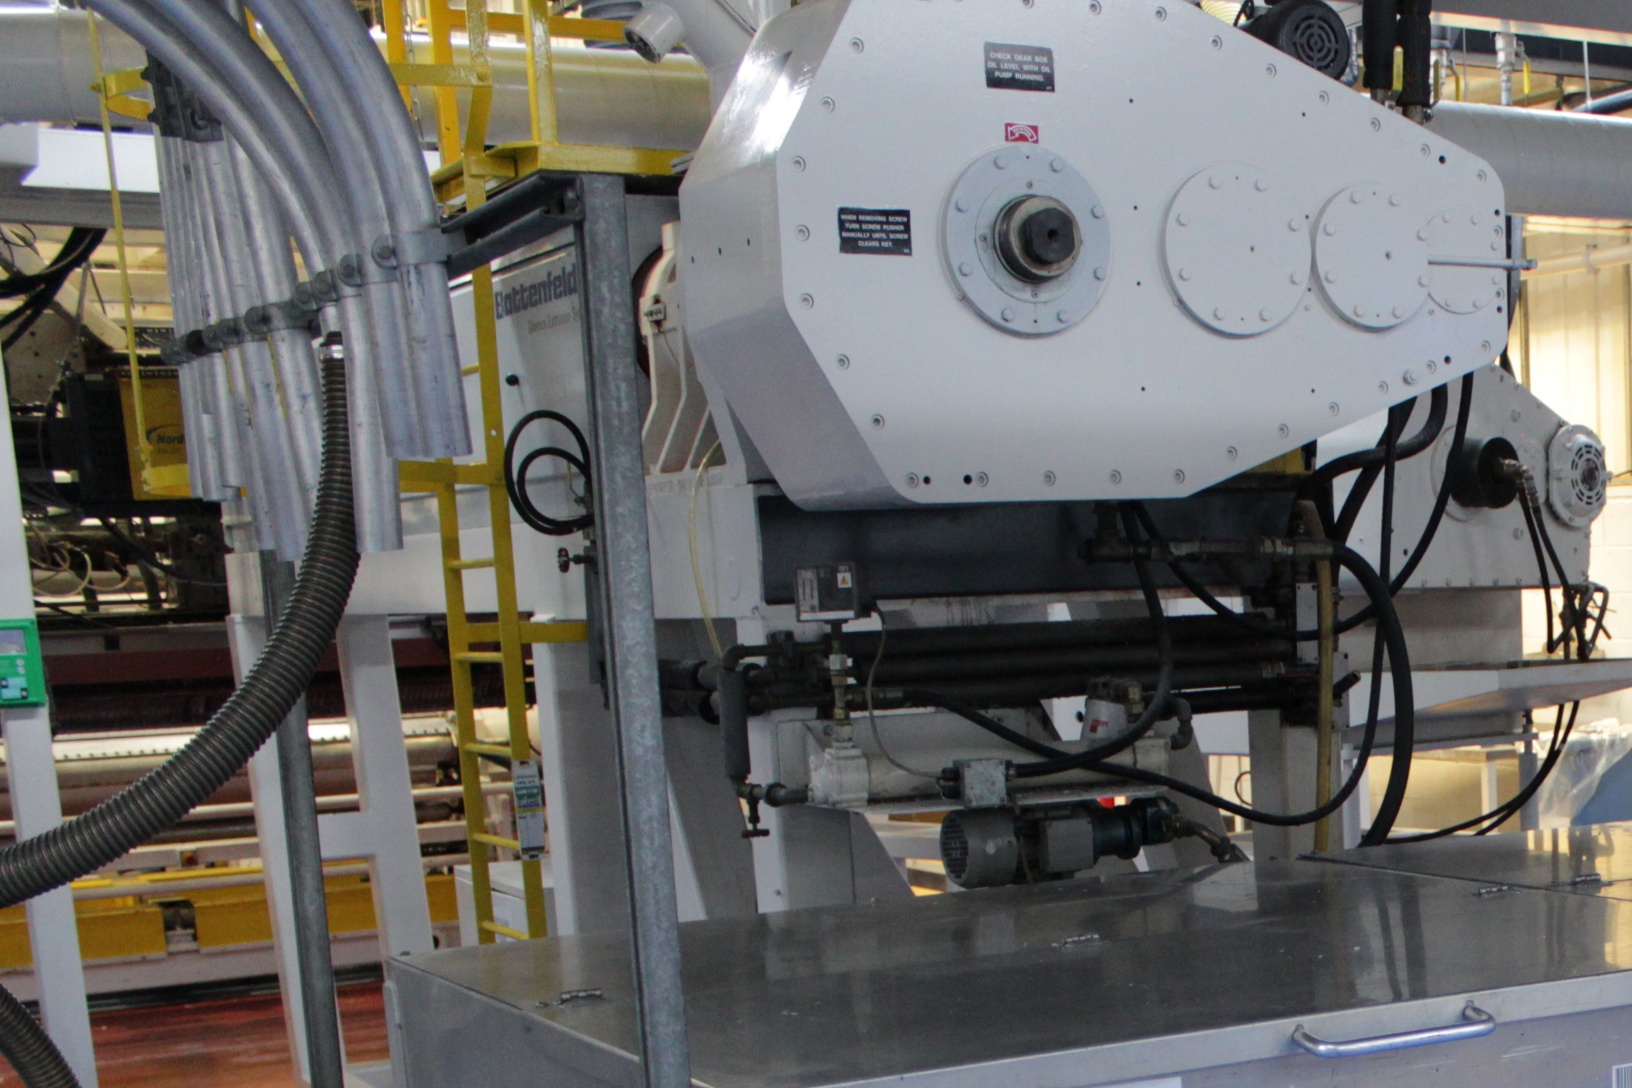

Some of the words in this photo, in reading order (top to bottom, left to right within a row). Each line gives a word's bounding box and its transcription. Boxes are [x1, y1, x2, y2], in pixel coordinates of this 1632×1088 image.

[989, 52, 1011, 60] CHECK
[1014, 54, 1032, 62] GEAR
[1034, 55, 1048, 63] BOX
[1000, 62, 1020, 70] LEVEL
[1022, 64, 1039, 72] WITH
[1041, 65, 1051, 73] OIL
[994, 70, 1013, 78] PUMP
[858, 214, 887, 222] REMOVING
[889, 232, 909, 240] SCREW
[156, 433, 185, 445] Nord
